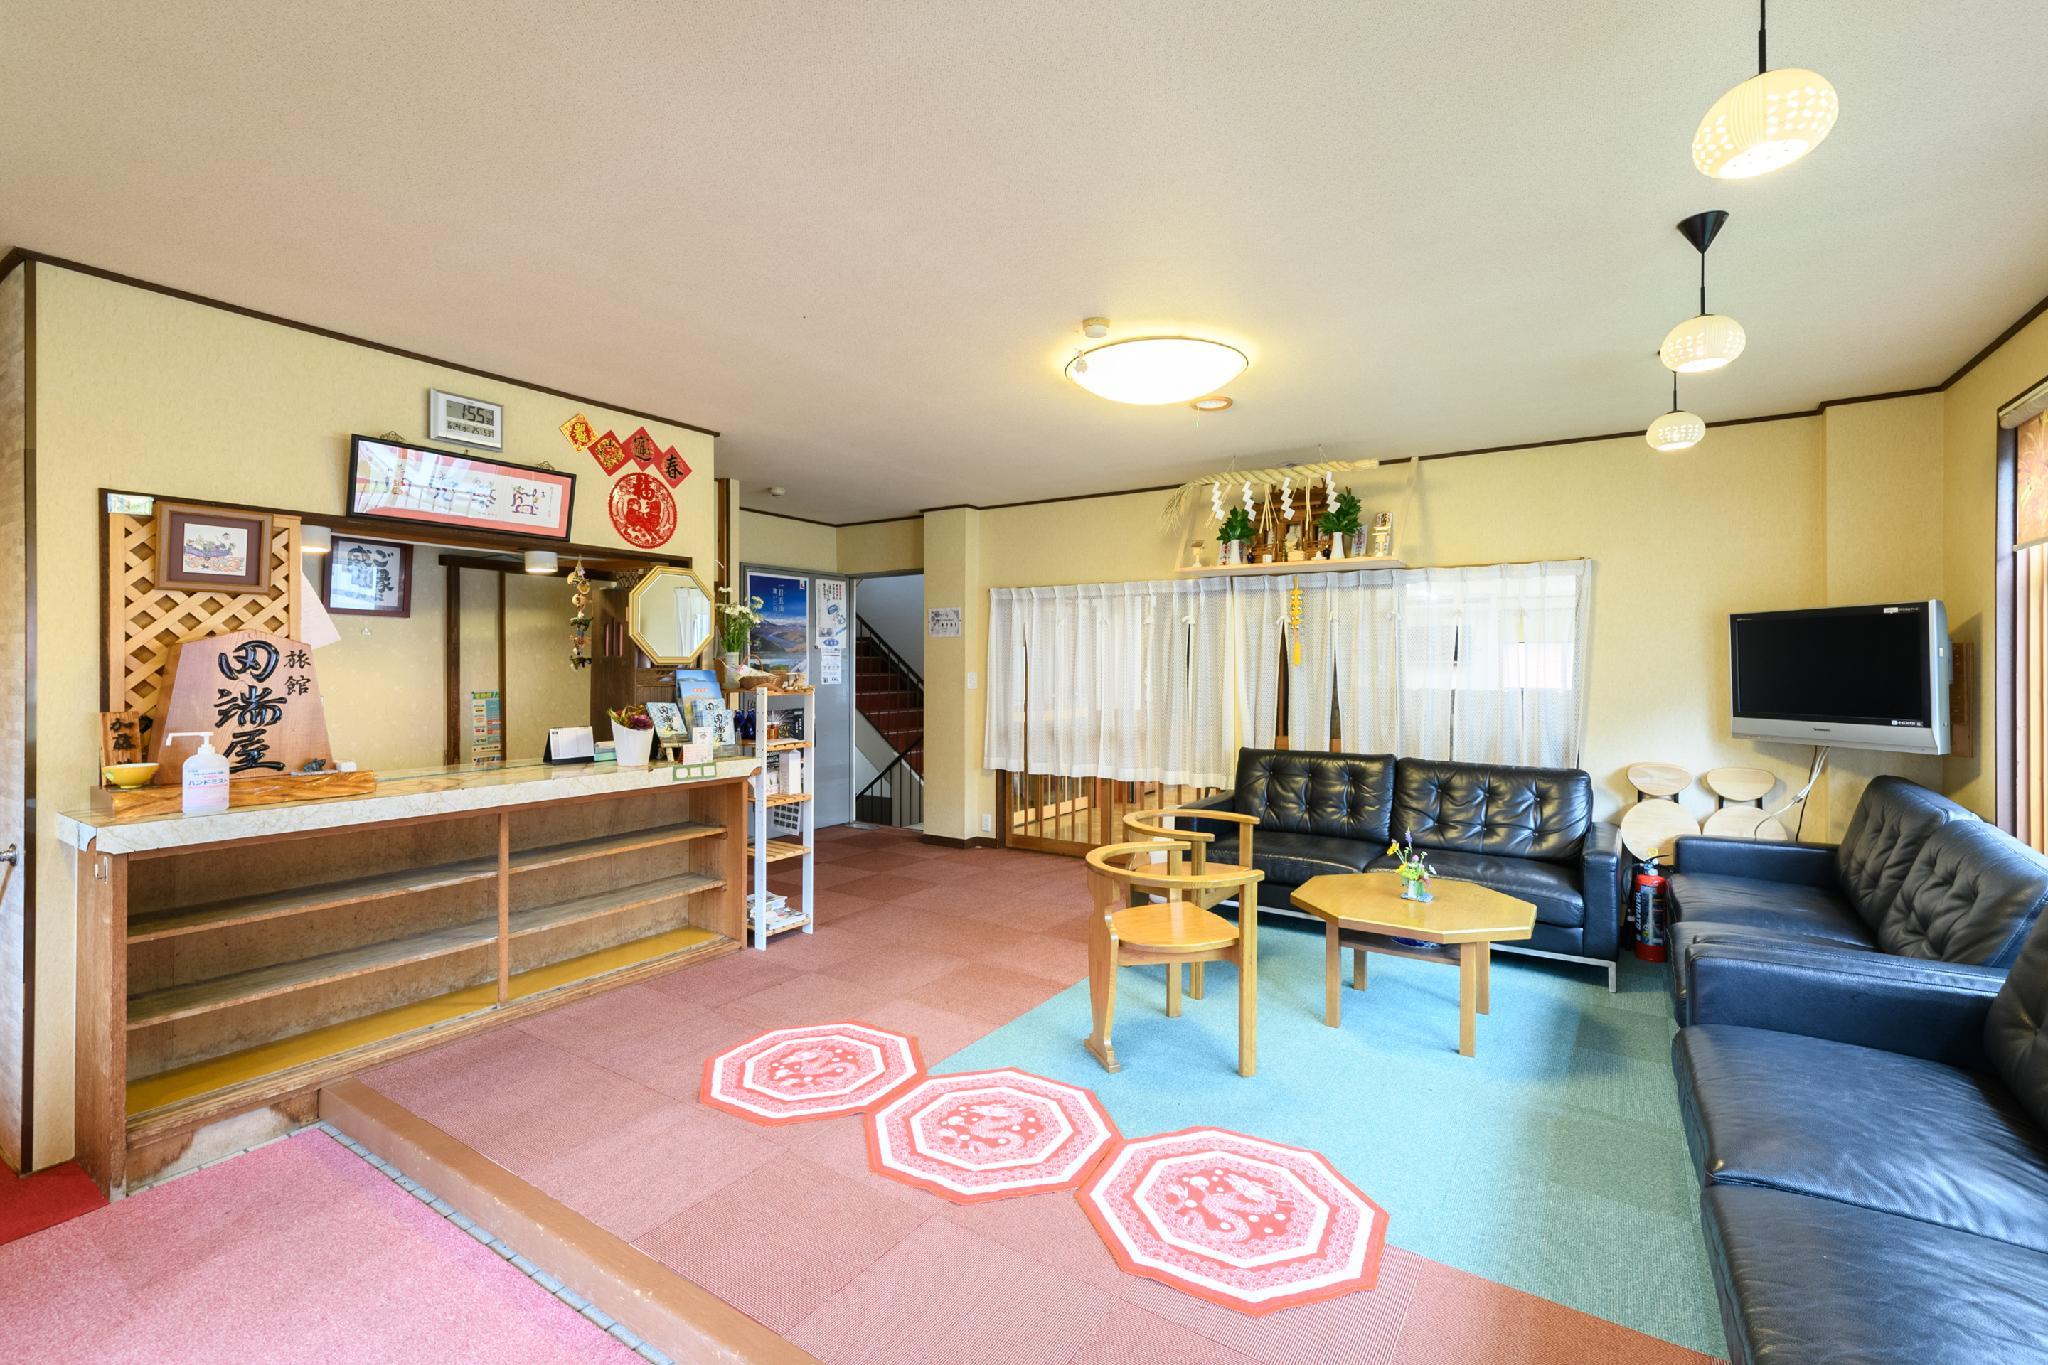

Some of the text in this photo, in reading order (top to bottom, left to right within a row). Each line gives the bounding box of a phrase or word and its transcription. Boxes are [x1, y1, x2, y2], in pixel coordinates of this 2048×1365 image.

[665, 454, 684, 480] 春
[283, 649, 312, 696] 旅館
[213, 639, 288, 775] 田端屋
